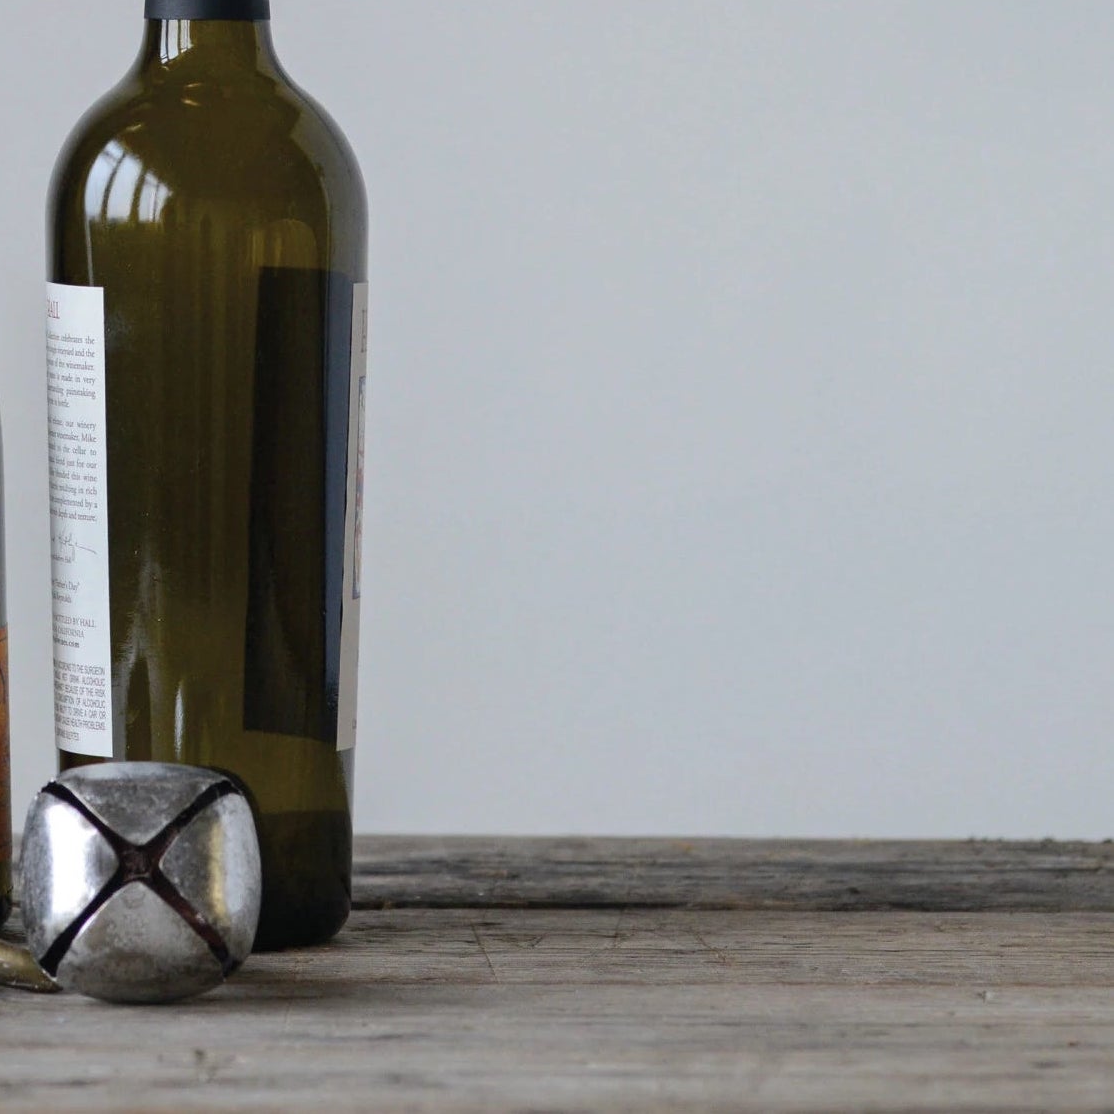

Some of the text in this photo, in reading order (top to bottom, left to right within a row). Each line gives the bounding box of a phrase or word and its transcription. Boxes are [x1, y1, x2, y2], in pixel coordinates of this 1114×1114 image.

[85, 335, 95, 345] the
[75, 348, 85, 357] and
[86, 348, 96, 357] the
[83, 376, 96, 386] very
[76, 421, 97, 432] winery
[81, 433, 97, 443] Mike
[89, 448, 97, 456] to
[76, 458, 85, 468] for
[86, 461, 97, 469] our
[83, 473, 98, 483] wine
[85, 486, 98, 496] rich
[84, 498, 93, 511] by
